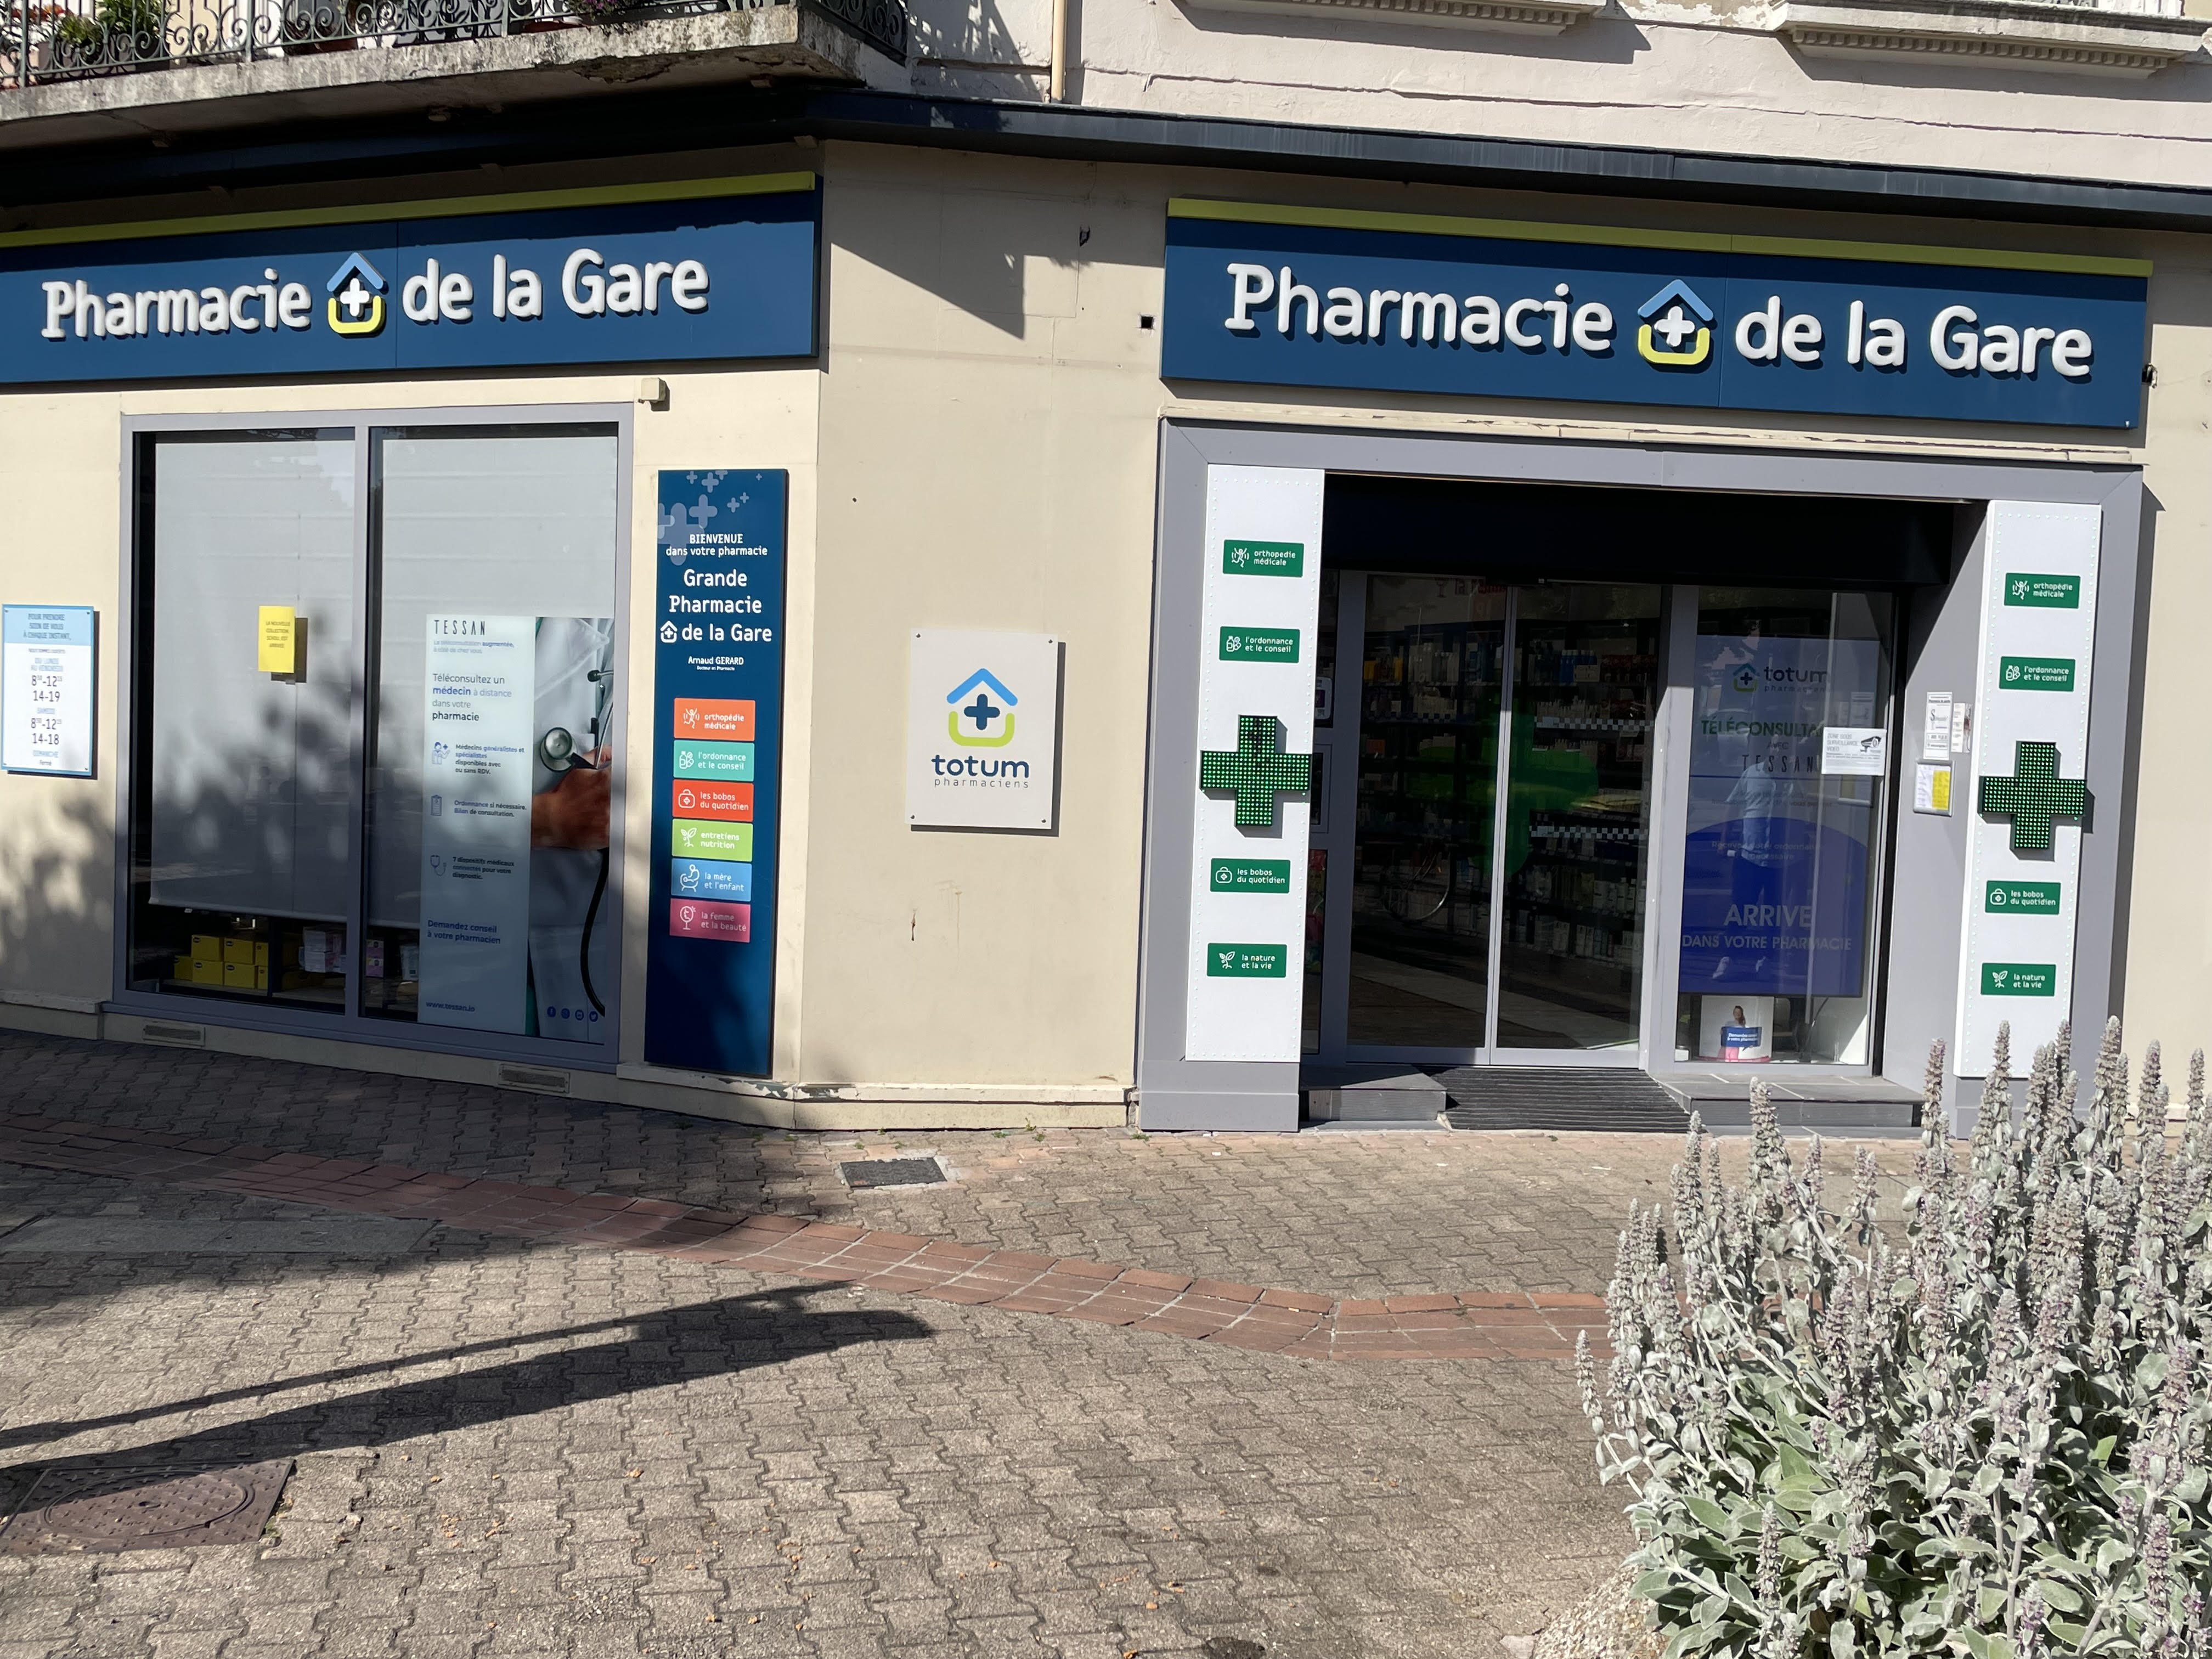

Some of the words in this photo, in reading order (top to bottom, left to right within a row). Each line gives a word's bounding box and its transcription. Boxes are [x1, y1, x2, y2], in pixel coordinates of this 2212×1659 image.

[41, 268, 311, 338] Pharmacie
[403, 258, 473, 321] de
[493, 253, 542, 318] la
[562, 248, 708, 314] Gare
[1224, 263, 1613, 351] Pharmacie
[1735, 295, 1822, 362] de
[1847, 300, 1905, 366] la
[1930, 305, 2092, 376] Gare
[690, 534, 743, 544] BIENVENUE
[666, 546, 687, 556] dans
[690, 547, 715, 556] votre
[719, 546, 768, 557] pharmacie
[684, 569, 747, 586] Grande
[669, 595, 761, 613] Pharmacie
[434, 620, 485, 635] TESSAN
[682, 624, 702, 640] de
[710, 624, 724, 641] la
[731, 624, 772, 641] Gare
[1245, 636, 1293, 646] l'ordonnance
[715, 657, 743, 665] GERARD
[1764, 667, 1827, 682] totum
[2024, 665, 2069, 675] l'ordonnance
[433, 673, 491, 684] Téléconsultez
[33, 690, 60, 702] 14-19
[432, 686, 471, 696] médecin
[480, 688, 512, 697] distance
[432, 699, 450, 708] dans
[432, 712, 479, 722] pharmacie
[704, 714, 744, 722] orthopédie
[32, 733, 59, 745] 14-18
[698, 752, 746, 761] l'ordonnance
[932, 755, 1029, 778] totum
[934, 777, 1028, 788] pharmaciens
[713, 792, 735, 800] bobos
[454, 800, 488, 808] Ordonnance
[712, 802, 749, 811] quotidien
[701, 832, 740, 840] entretiens
[701, 840, 735, 849] nutrition
[715, 882, 744, 891] l'enfant
[710, 912, 734, 921] femme
[428, 920, 468, 932] Demandez
[470, 924, 497, 933] conseil
[720, 922, 747, 932] beauté
[455, 933, 500, 945] pharmacien
[1682, 935, 1719, 948] DANS
[1724, 935, 1767, 949] VOTRE
